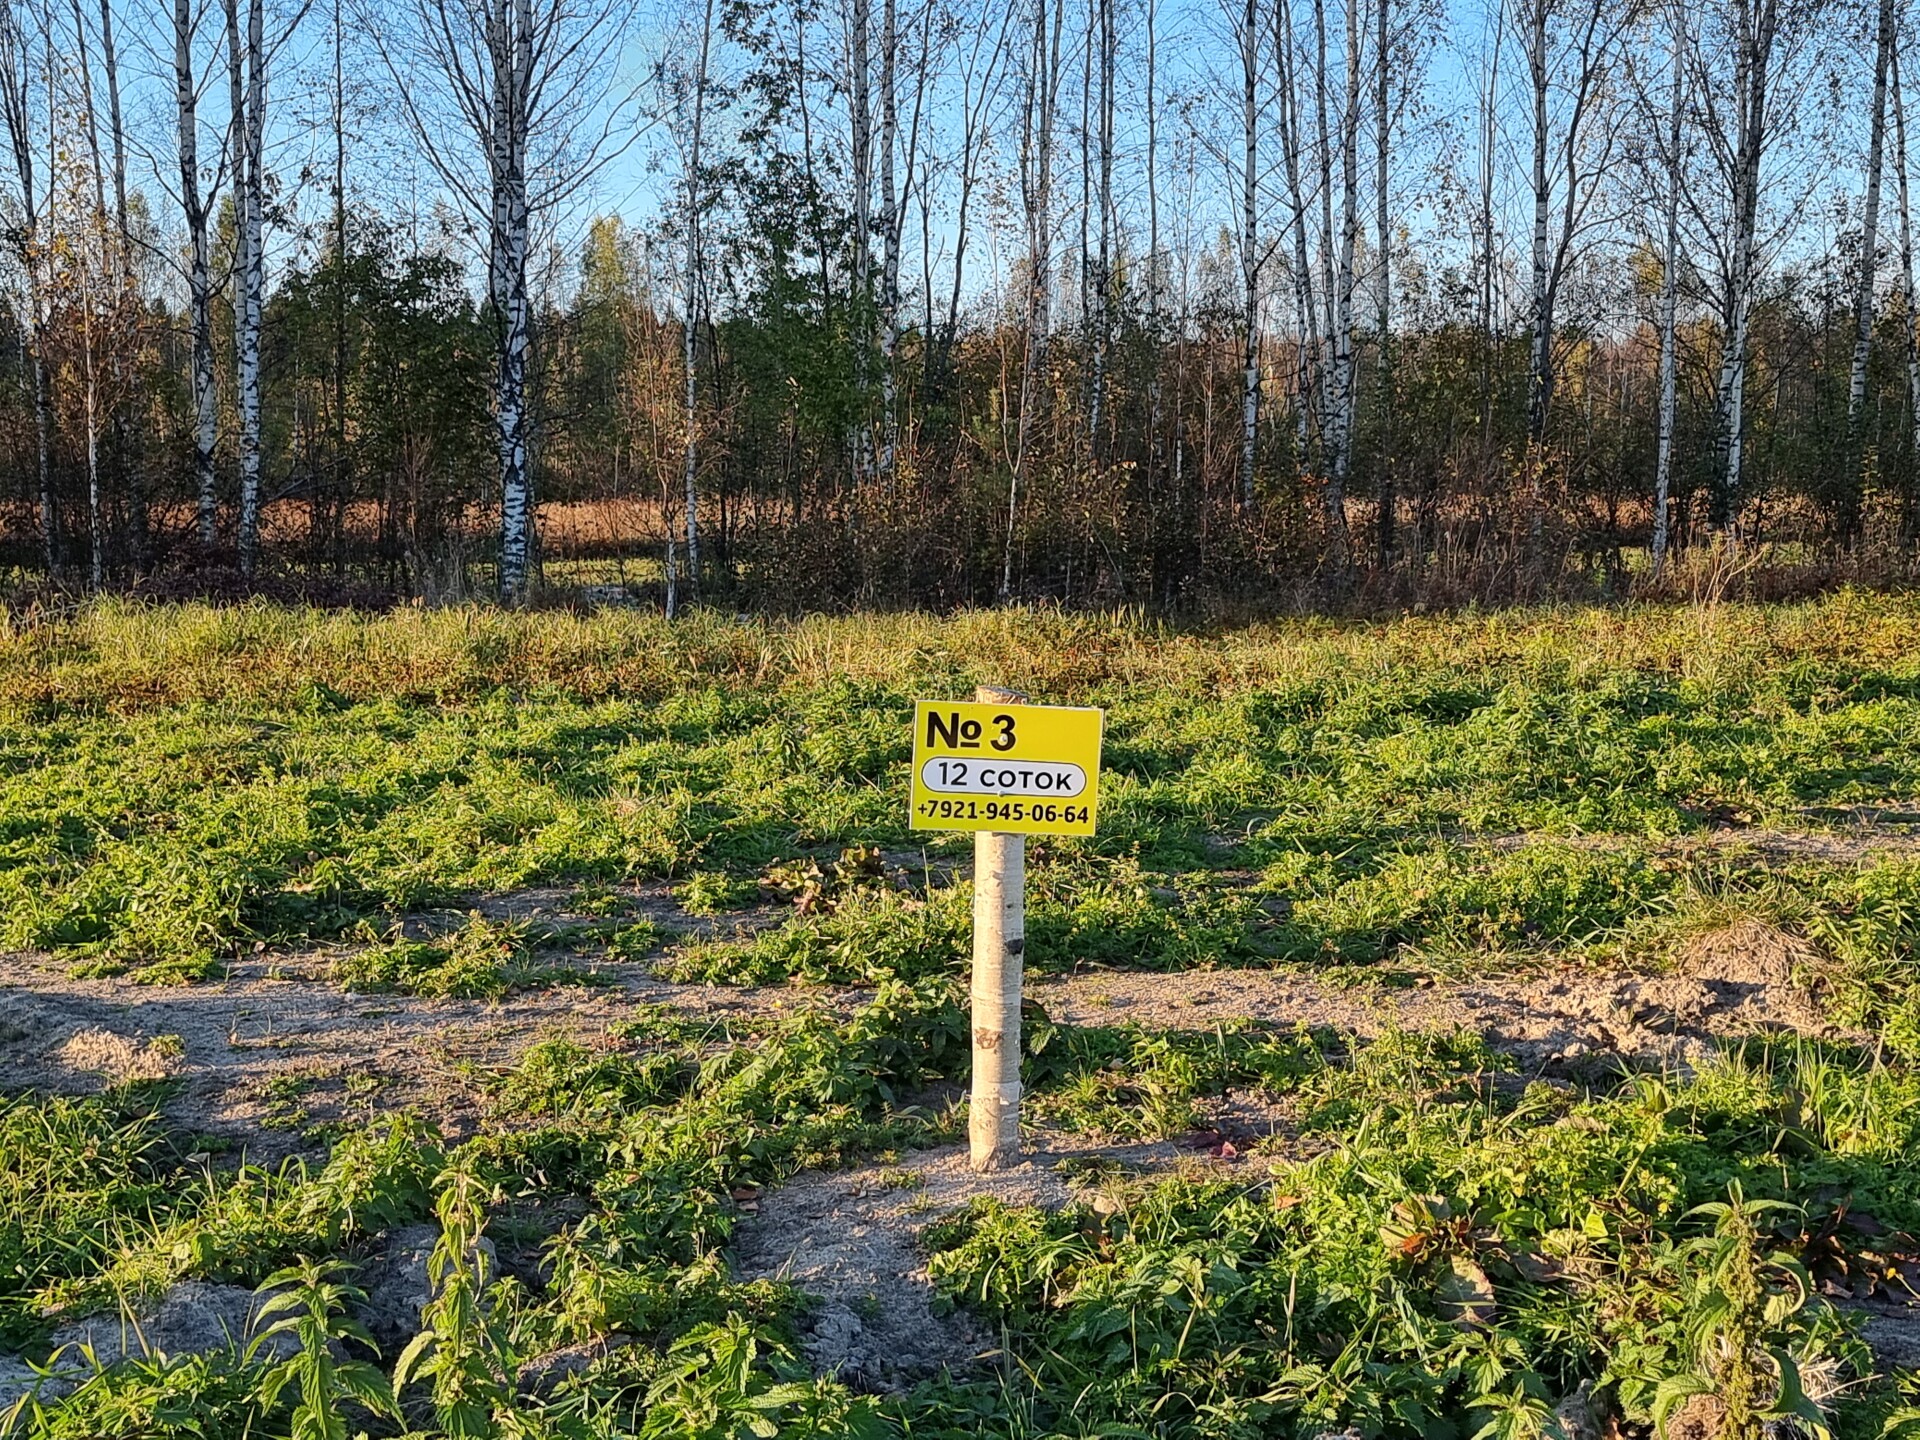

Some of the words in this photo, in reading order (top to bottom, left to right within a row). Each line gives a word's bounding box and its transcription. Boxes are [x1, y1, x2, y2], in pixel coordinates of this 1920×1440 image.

[990, 714, 1017, 752] 3
[938, 762, 968, 786] 12
[917, 800, 1089, 824] +7921-945-06-64
